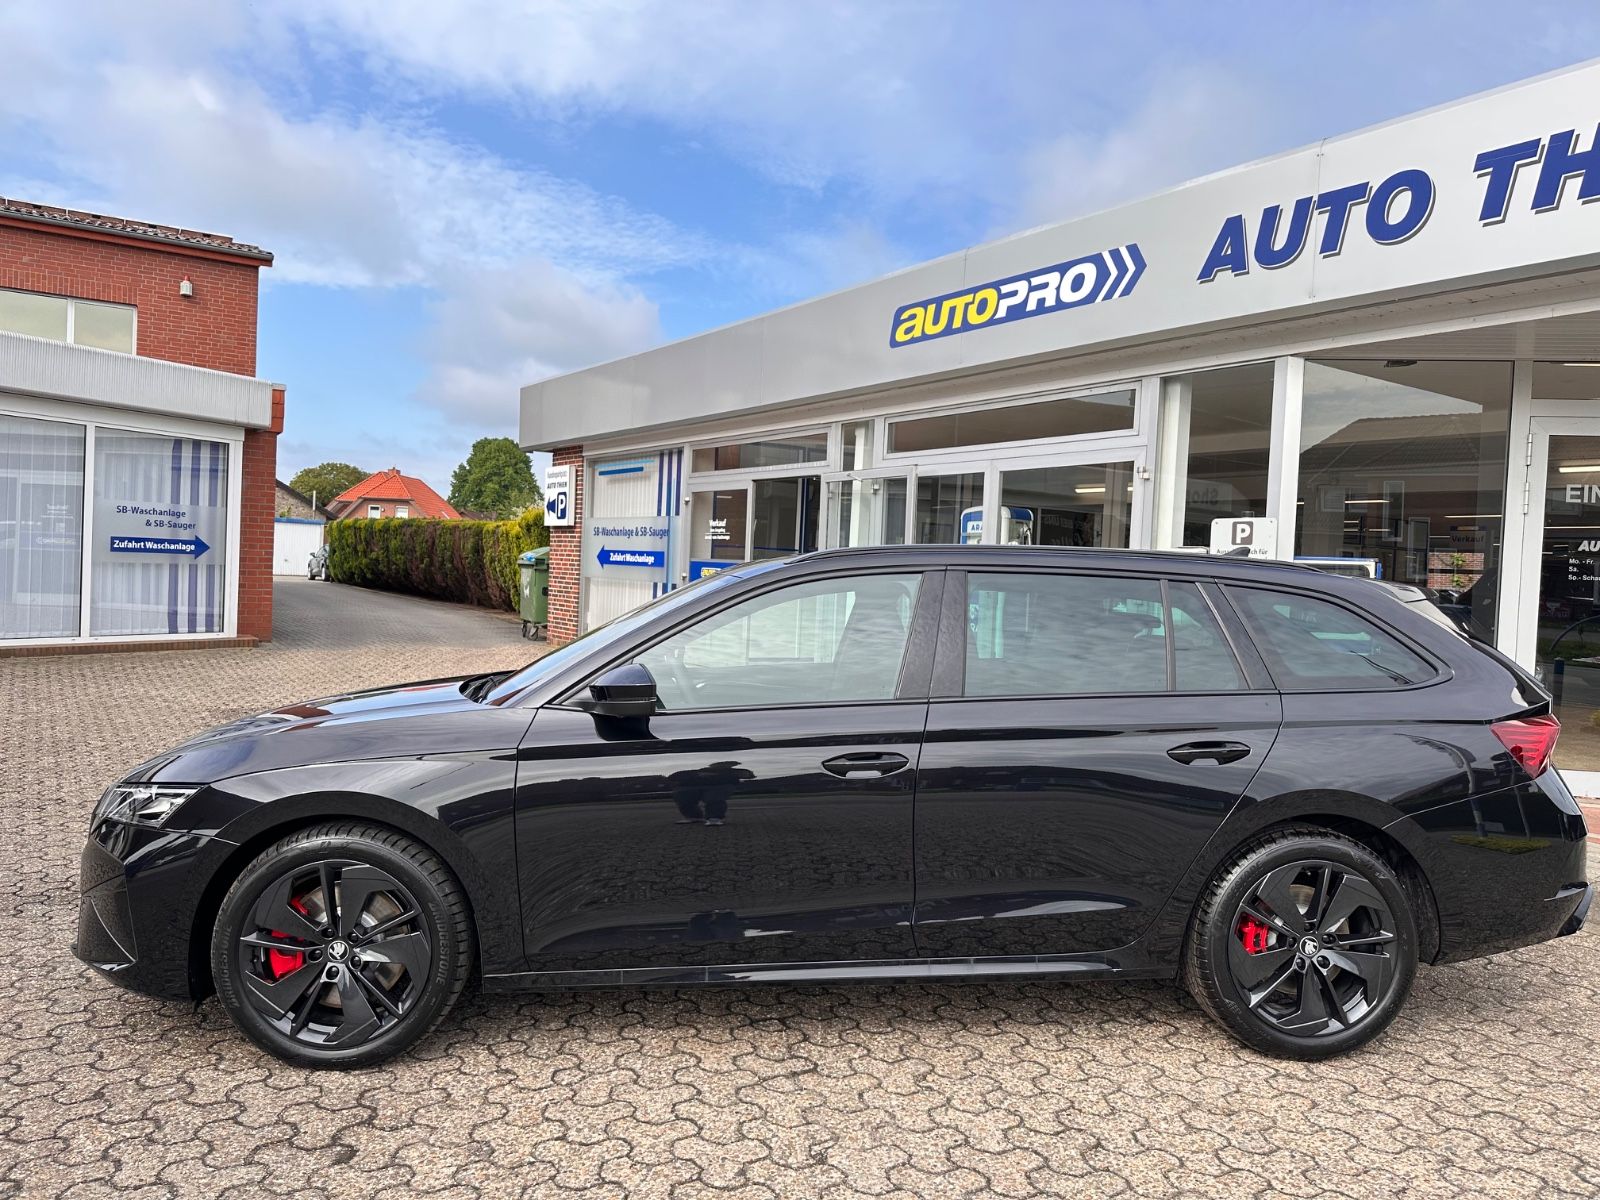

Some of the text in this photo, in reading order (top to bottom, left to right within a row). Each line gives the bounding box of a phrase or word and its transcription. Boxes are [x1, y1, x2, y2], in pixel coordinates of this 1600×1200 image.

[1197, 122, 1600, 284] AUTO TH
[116, 505, 186, 518] SB-Waschanlage
[145, 519, 196, 530] & SB-Sauger
[593, 526, 670, 540] SB-Waschanlage & SB-Sauger
[1236, 524, 1251, 544] P
[113, 540, 195, 552] Zufahrt Waschanlage
